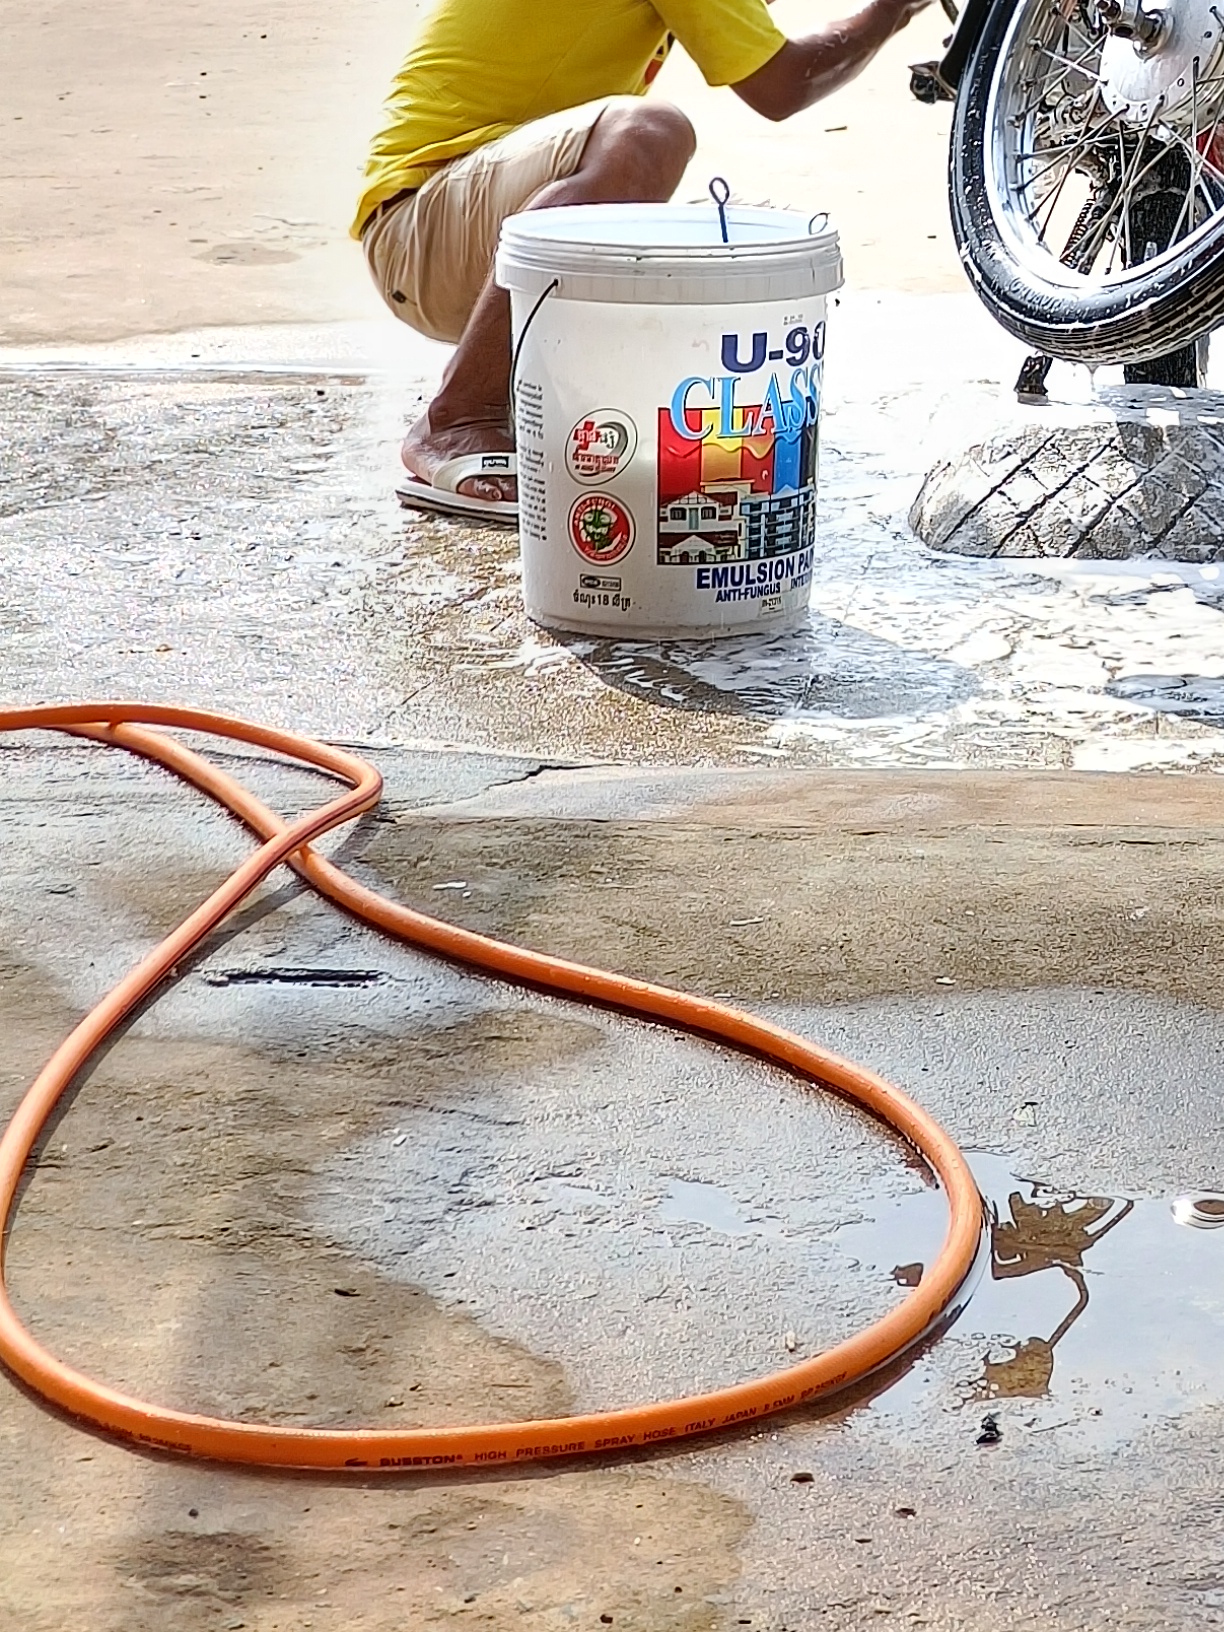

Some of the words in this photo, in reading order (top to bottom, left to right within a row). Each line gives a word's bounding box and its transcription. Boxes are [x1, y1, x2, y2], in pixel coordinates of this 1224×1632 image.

[696, 556, 795, 590] EMULSION
[715, 581, 781, 603] ANTI-FUNGUS
[474, 1450, 507, 1461] HIGH
[515, 1441, 586, 1458] PRESSURE
[594, 1433, 636, 1449] SPRAY
[643, 1426, 677, 1441] HOSE
[684, 1417, 716, 1434] ITALY
[721, 1406, 757, 1425] JAPAN
